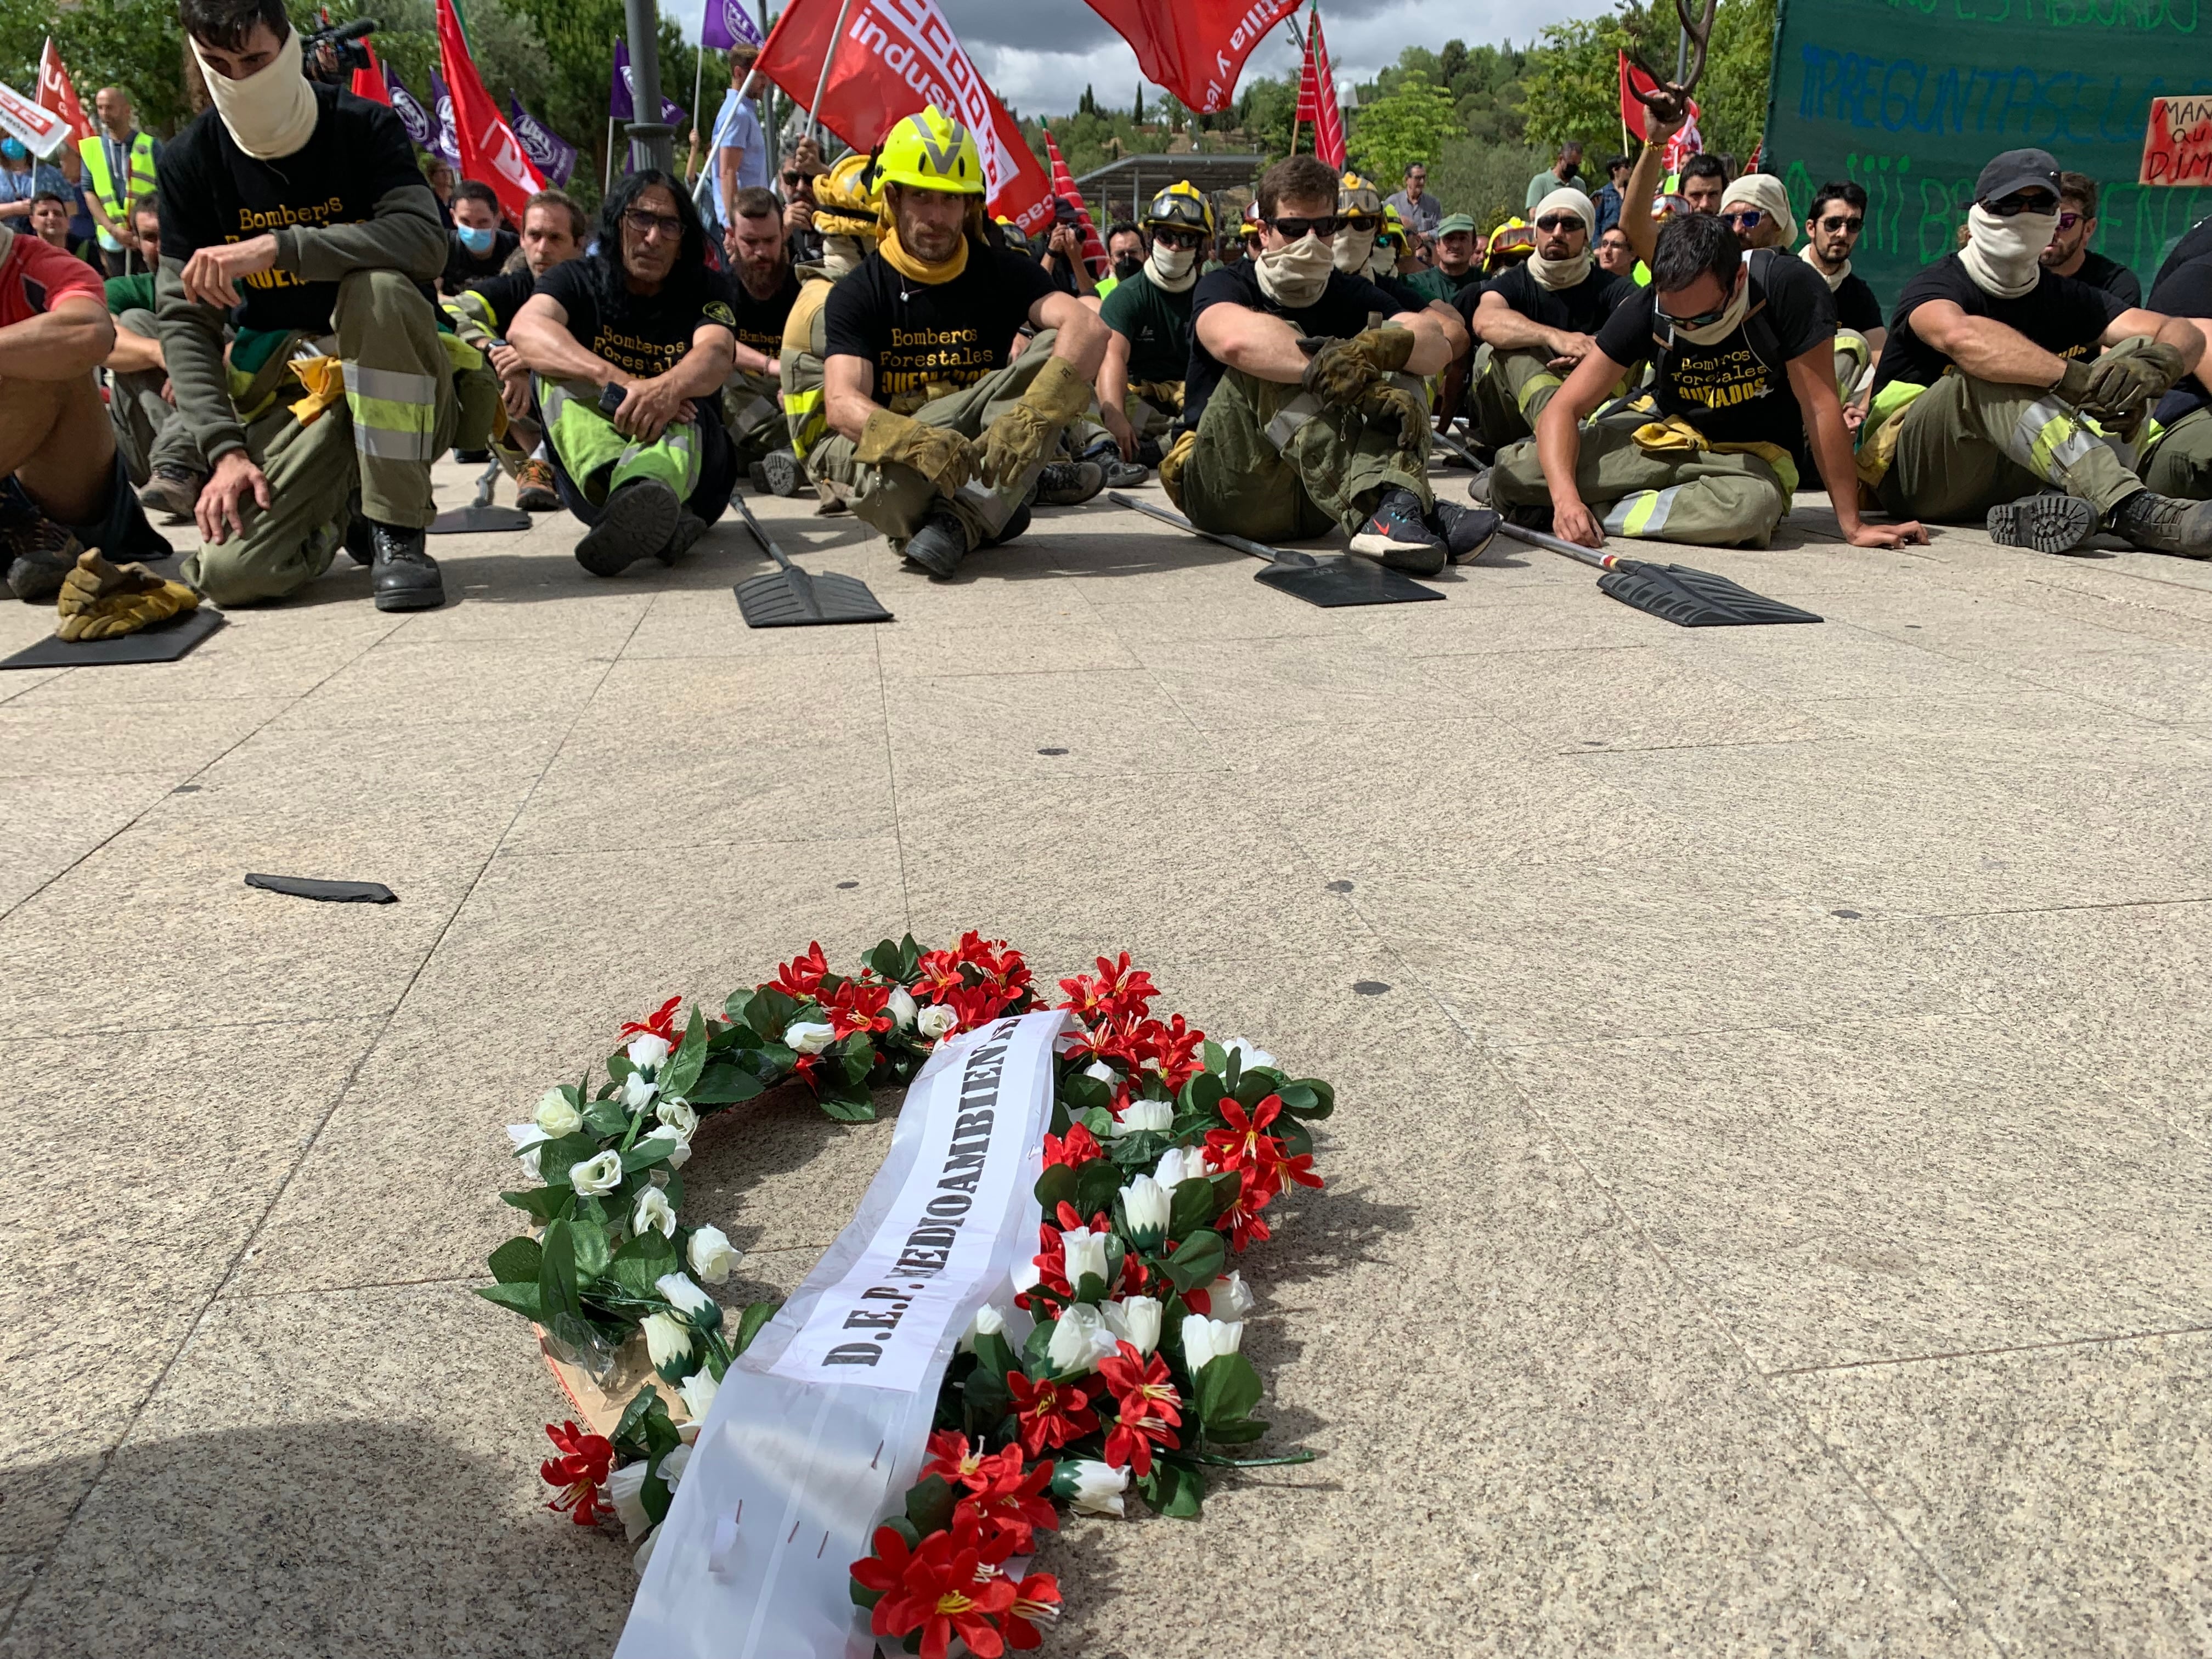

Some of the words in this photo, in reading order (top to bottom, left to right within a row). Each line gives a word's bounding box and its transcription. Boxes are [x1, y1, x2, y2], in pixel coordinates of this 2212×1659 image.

[849, 7, 960, 122] indust
[891, 328, 978, 347] Bomberos
[879, 347, 994, 368] Forestales
